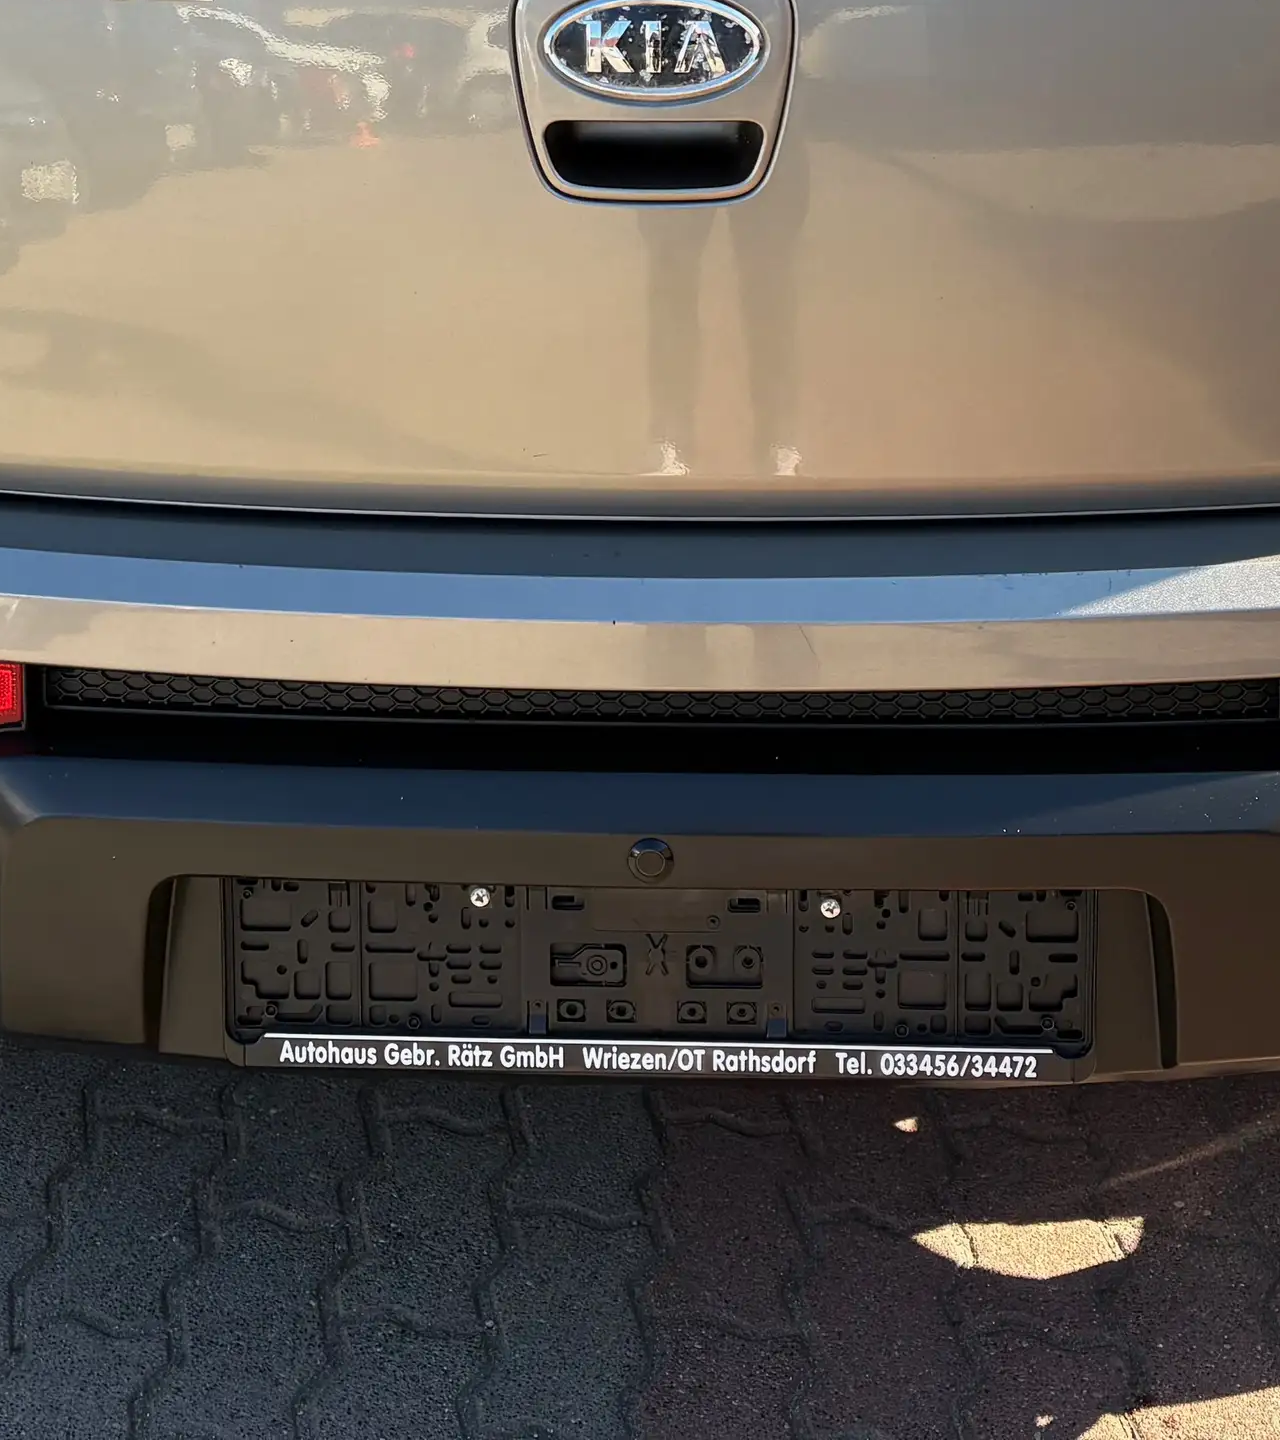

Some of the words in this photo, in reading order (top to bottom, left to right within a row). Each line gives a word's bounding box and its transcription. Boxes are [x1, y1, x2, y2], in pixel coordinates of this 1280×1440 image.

[582, 19, 727, 76] KIA
[279, 1039, 378, 1066] Autohaus
[383, 1042, 441, 1067] Gebr.
[447, 1043, 494, 1068] Rätz
[499, 1044, 565, 1069] GmbH
[582, 1045, 706, 1073] Wriezen/OT
[712, 1048, 817, 1074] Rathsdorf
[835, 1050, 873, 1076] Tel.
[879, 1052, 1038, 1079] 033456/34472
